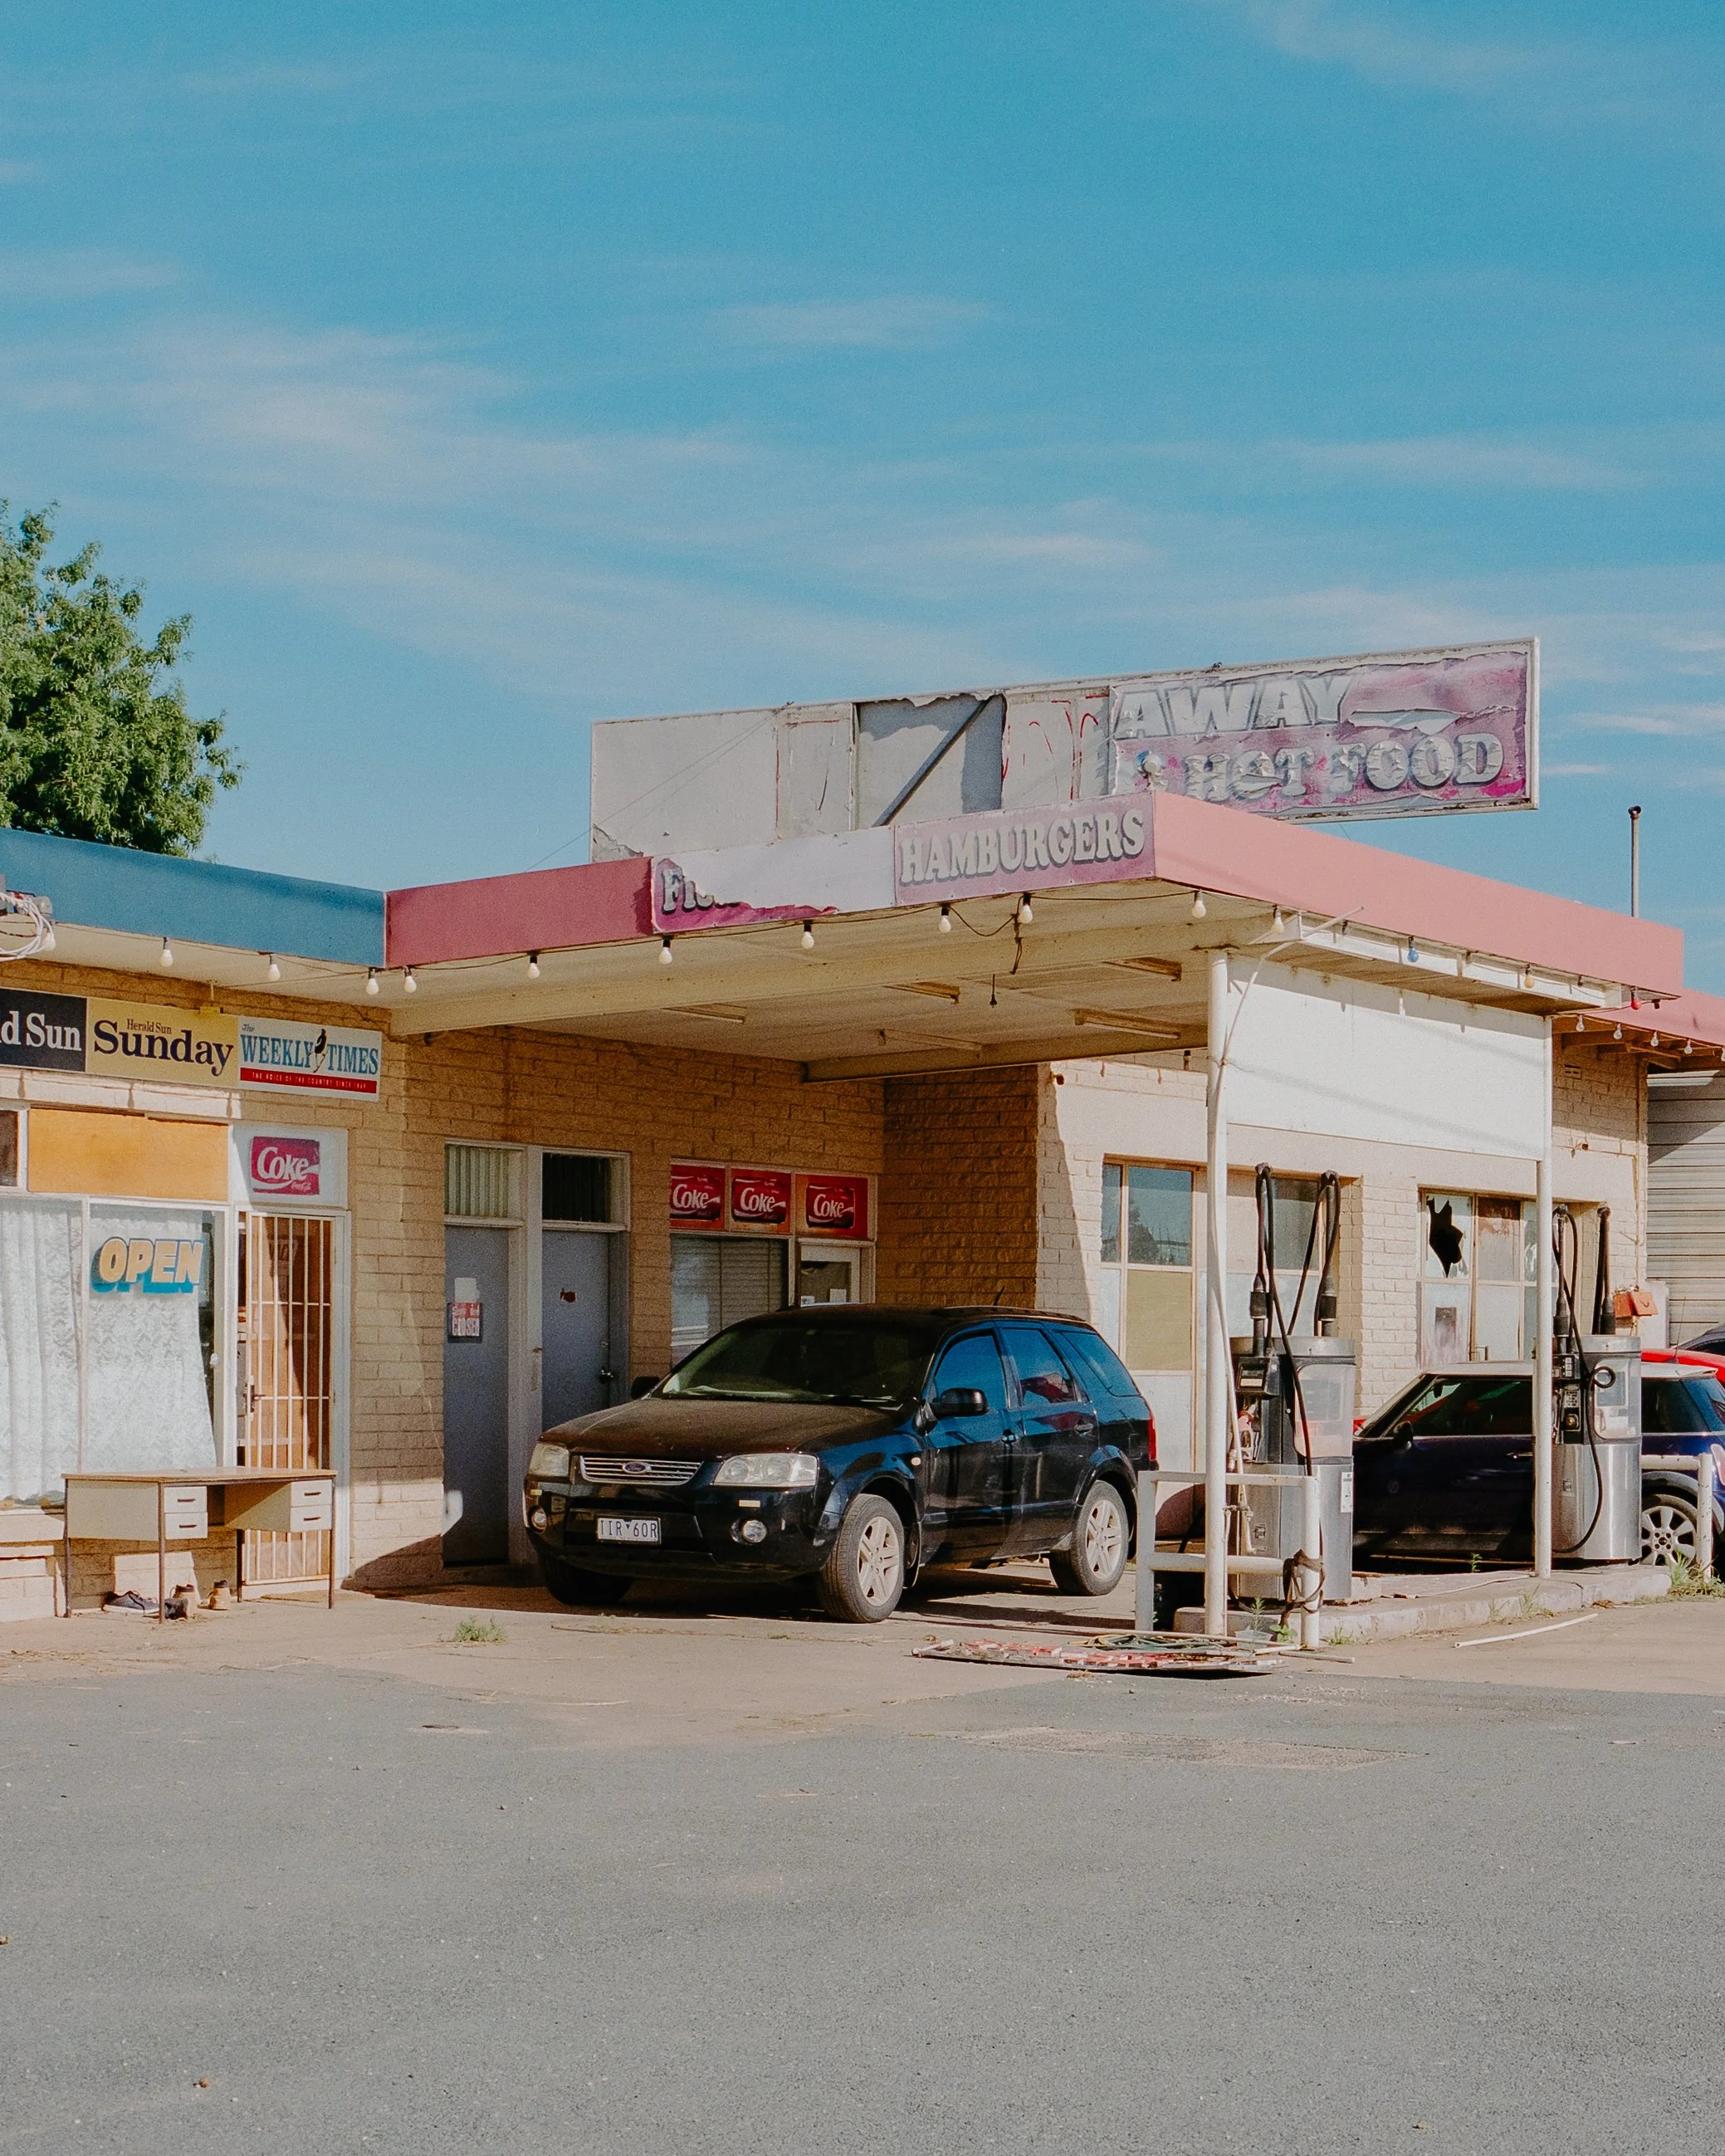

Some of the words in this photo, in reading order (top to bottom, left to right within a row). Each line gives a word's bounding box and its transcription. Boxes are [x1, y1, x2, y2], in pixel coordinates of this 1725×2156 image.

[1115, 675, 1356, 739] AWAY
[1185, 746, 1314, 802] HOT
[1330, 733, 1503, 800] FOOD
[899, 809, 1146, 887] HAMBURGERS
[26, 1013, 81, 1052] Sun
[127, 1019, 154, 1033] Herald
[156, 1022, 172, 1034] Sun
[94, 1019, 234, 1077] Sunday
[241, 1034, 313, 1068] WEEKLY
[327, 1044, 379, 1075] TIMES
[257, 1146, 310, 1181] Coke
[672, 1184, 710, 1209] Coke
[740, 1187, 776, 1212] Coke
[814, 1194, 845, 1217] Coke
[92, 1236, 204, 1291] OPEN
